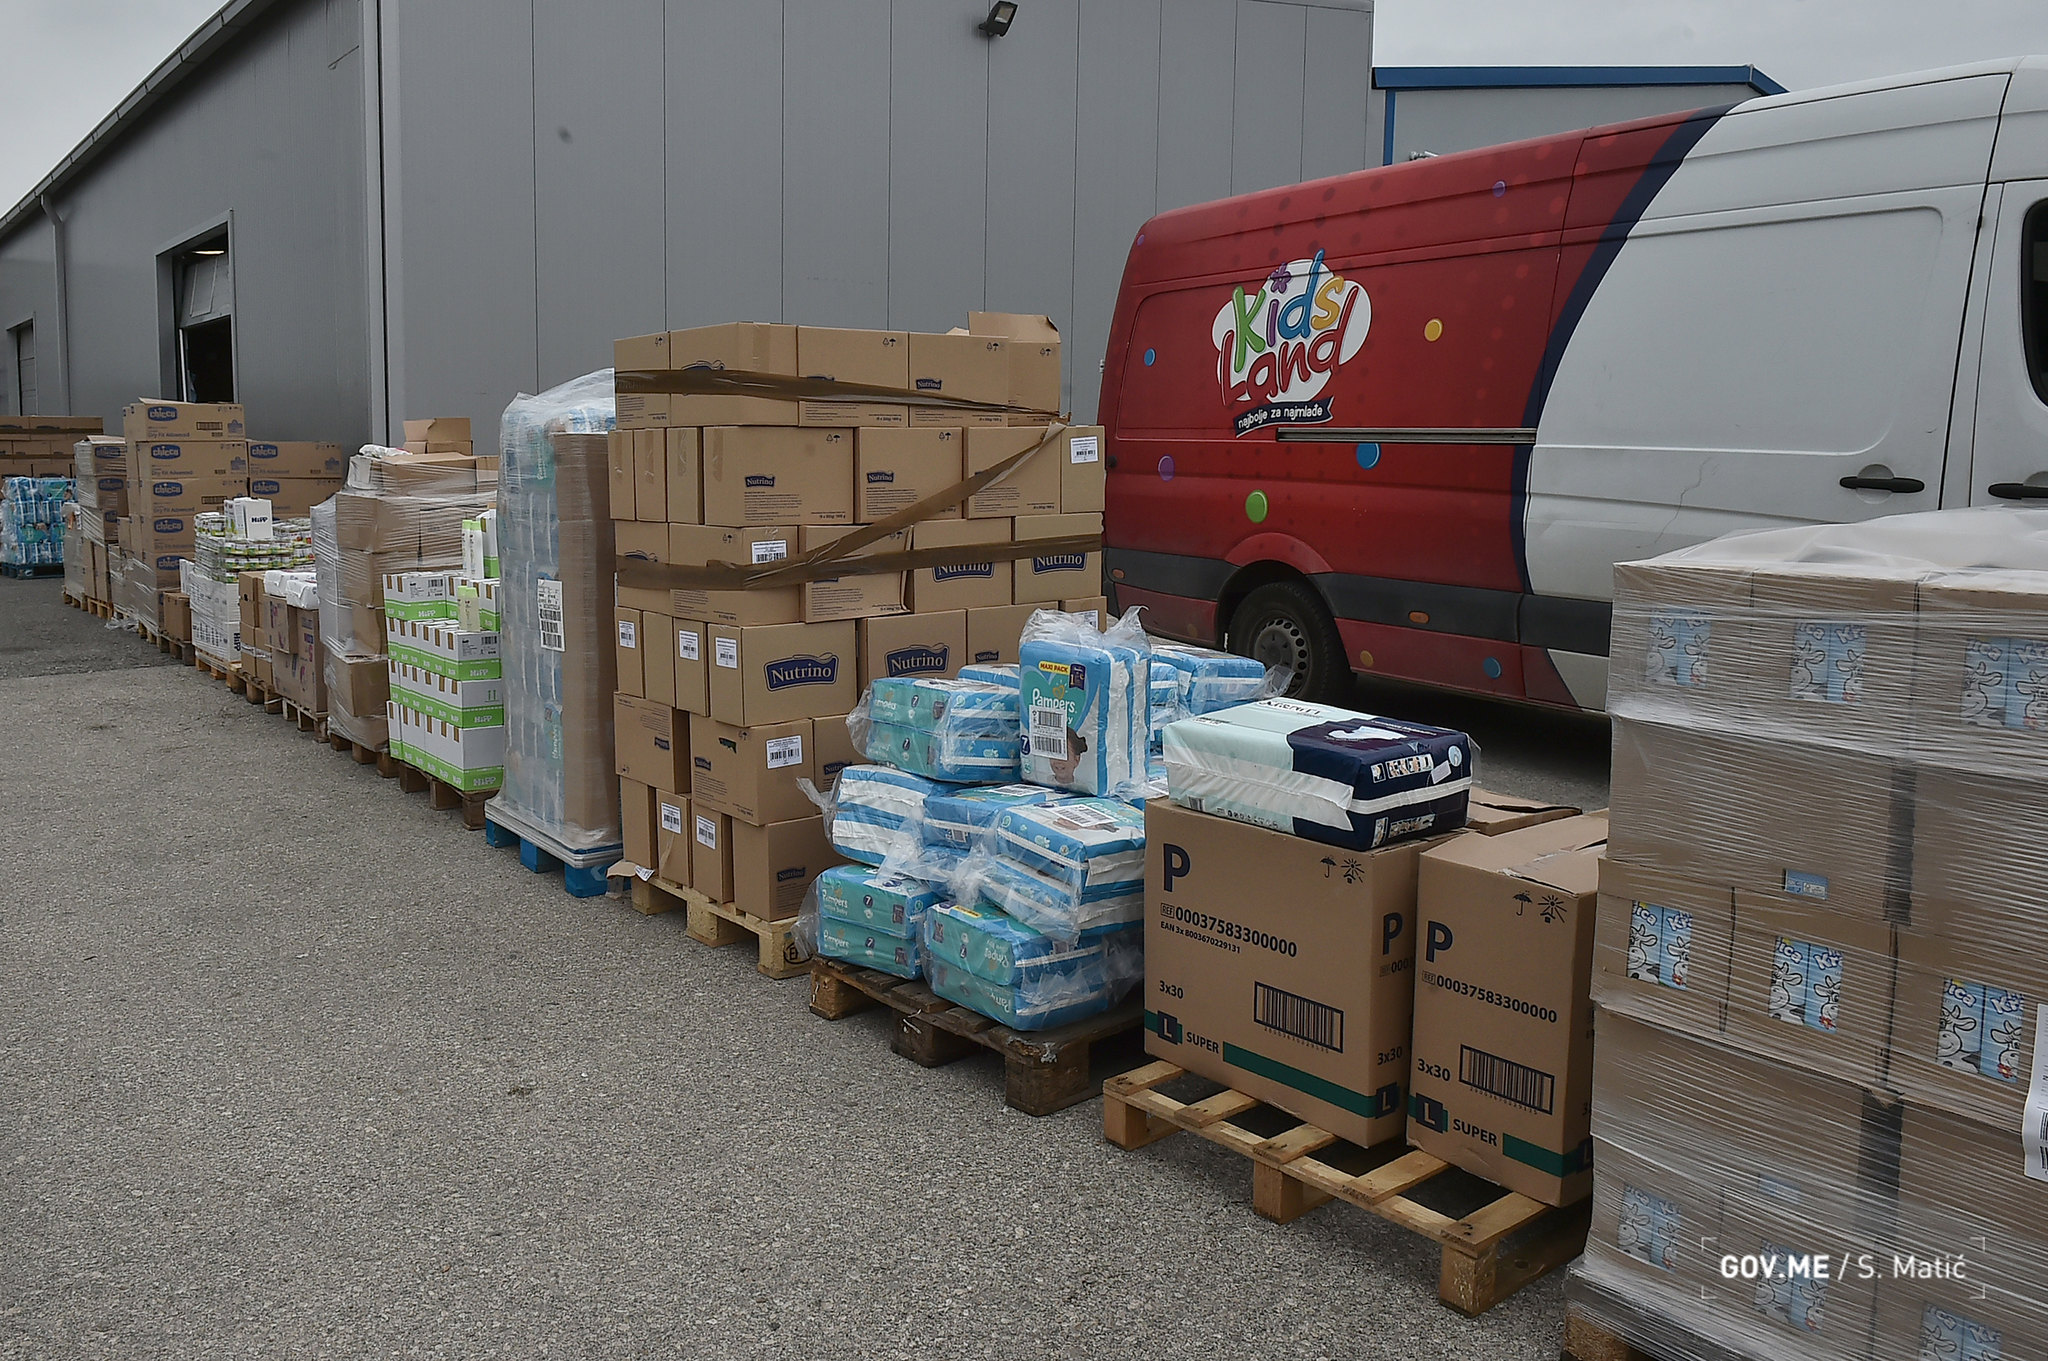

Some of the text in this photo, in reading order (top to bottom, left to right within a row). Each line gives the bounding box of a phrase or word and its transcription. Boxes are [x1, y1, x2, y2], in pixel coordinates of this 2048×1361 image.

[1232, 248, 1344, 373] Kids
[1220, 285, 1359, 404] Land
[917, 380, 941, 389] Nutrino
[150, 407, 176, 418] chicco
[1238, 403, 1323, 429] najbolje za najmlađe
[153, 445, 179, 456] chicco
[252, 445, 276, 456] chicco
[254, 482, 278, 492] chicco
[747, 478, 773, 486] Nutrino
[868, 473, 893, 482] Nutrino
[155, 483, 181, 493] chicco
[156, 519, 182, 530] chicco
[1036, 551, 1083, 567] Nutrino
[890, 653, 944, 673] Nutrino
[976, 652, 998, 662] Nutrino
[771, 662, 832, 684] Nutrino
[1040, 663, 1069, 674] MAXI PACK
[1033, 688, 1076, 713] Pampers
[1022, 737, 1028, 749] 7
[473, 777, 496, 786] HiPP
[778, 869, 804, 880] Nutrino
[1163, 843, 1191, 892] P
[1632, 901, 1657, 926] ica
[1161, 921, 1240, 954] EAN 3x 8003670229131
[1162, 904, 1297, 958] REF 00037583300000
[1382, 912, 1403, 956] P
[1425, 920, 1454, 963] P
[1776, 941, 1803, 964] ica
[1159, 980, 1184, 1000] 3x30
[1424, 972, 1558, 1023] REF 00037583300000
[1944, 982, 1976, 1008] ica
[1163, 1017, 1172, 1037] L
[1186, 1031, 1219, 1054] SUPER
[1377, 1046, 1403, 1066] 3x30
[1417, 1058, 1451, 1082] 3x30
[1382, 1092, 1391, 1110] L
[1422, 1101, 1435, 1124] L
[1453, 1118, 1497, 1147] SUPER
